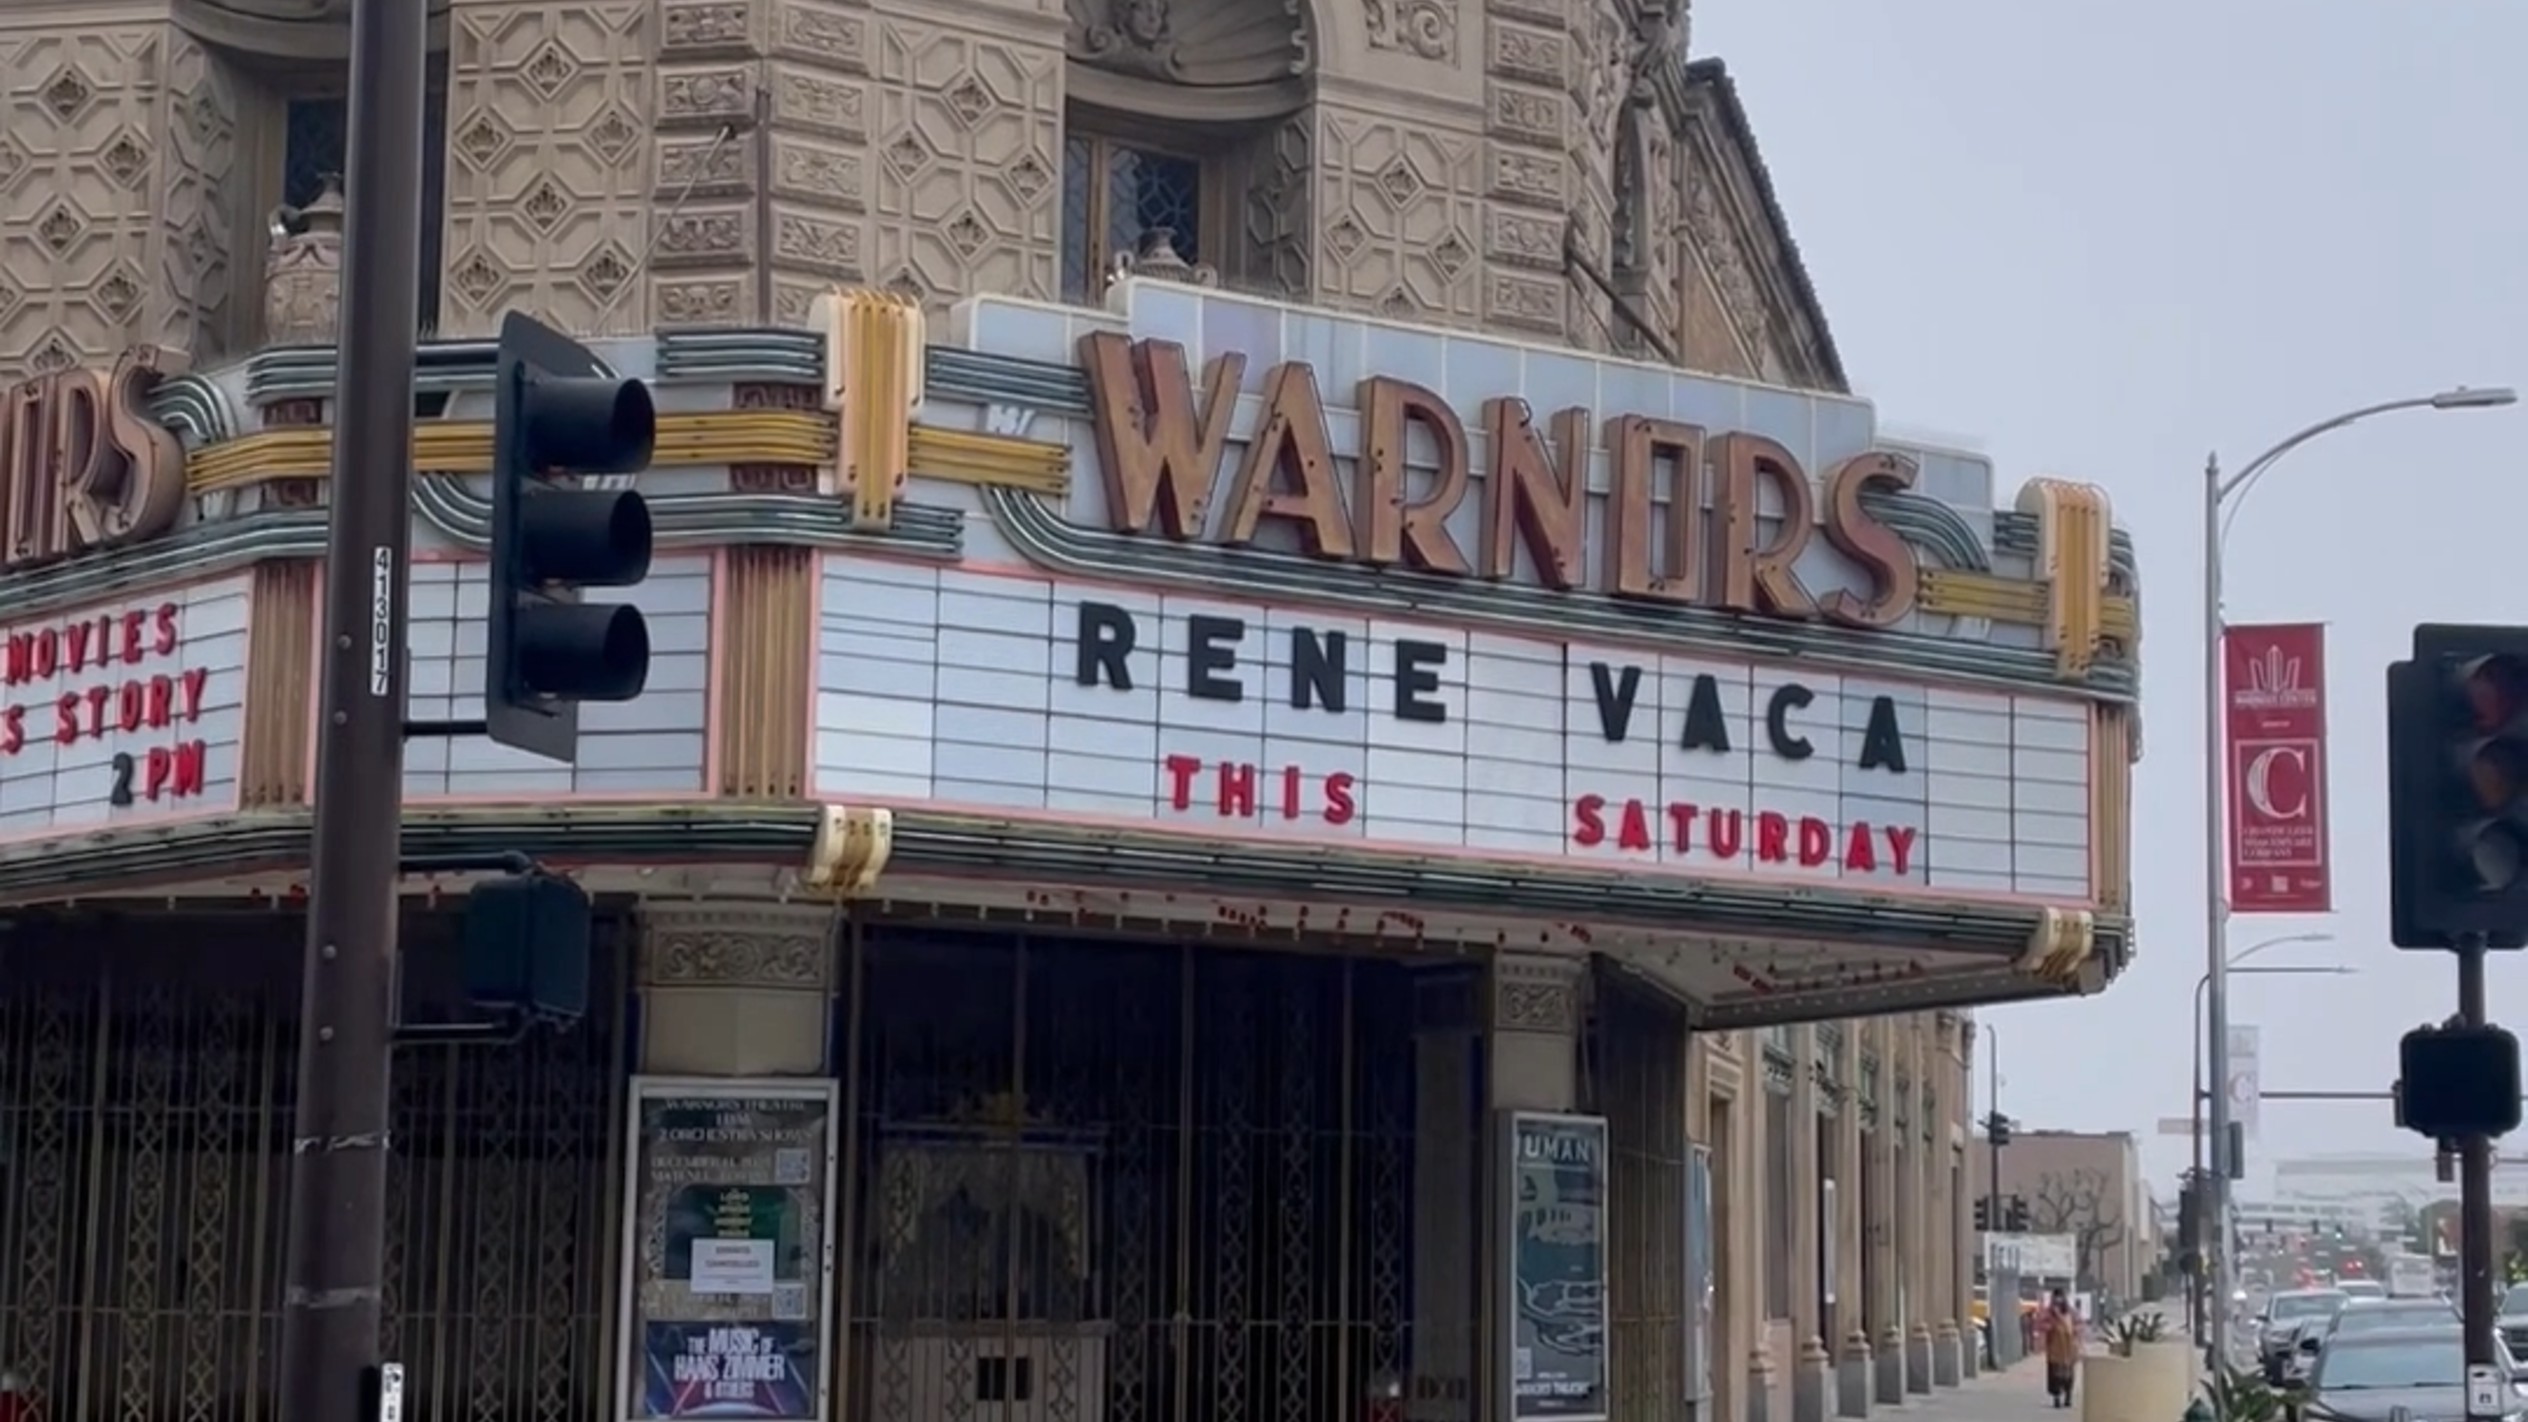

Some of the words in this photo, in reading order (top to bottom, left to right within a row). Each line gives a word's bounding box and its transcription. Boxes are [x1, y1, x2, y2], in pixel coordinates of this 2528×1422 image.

[0, 344, 191, 566] ORS
[1077, 331, 1923, 629] WARNORS
[6, 602, 178, 687] MOVIES
[374, 549, 389, 693] 413017
[56, 667, 208, 747] STORY
[1077, 602, 1448, 722] RENE
[1589, 662, 1908, 773] VACA
[111, 751, 134, 806] 2
[144, 739, 207, 804] PM
[2246, 747, 2306, 819] C
[1167, 755, 1355, 824] THIS
[1573, 794, 1917, 874] SATURDAY
[1516, 1133, 1590, 1163] UMAN
[673, 1354, 720, 1381] HANS
[722, 1355, 786, 1382] ZIMMER
[687, 1337, 706, 1355] THE
[708, 1327, 760, 1356] MUSIC
